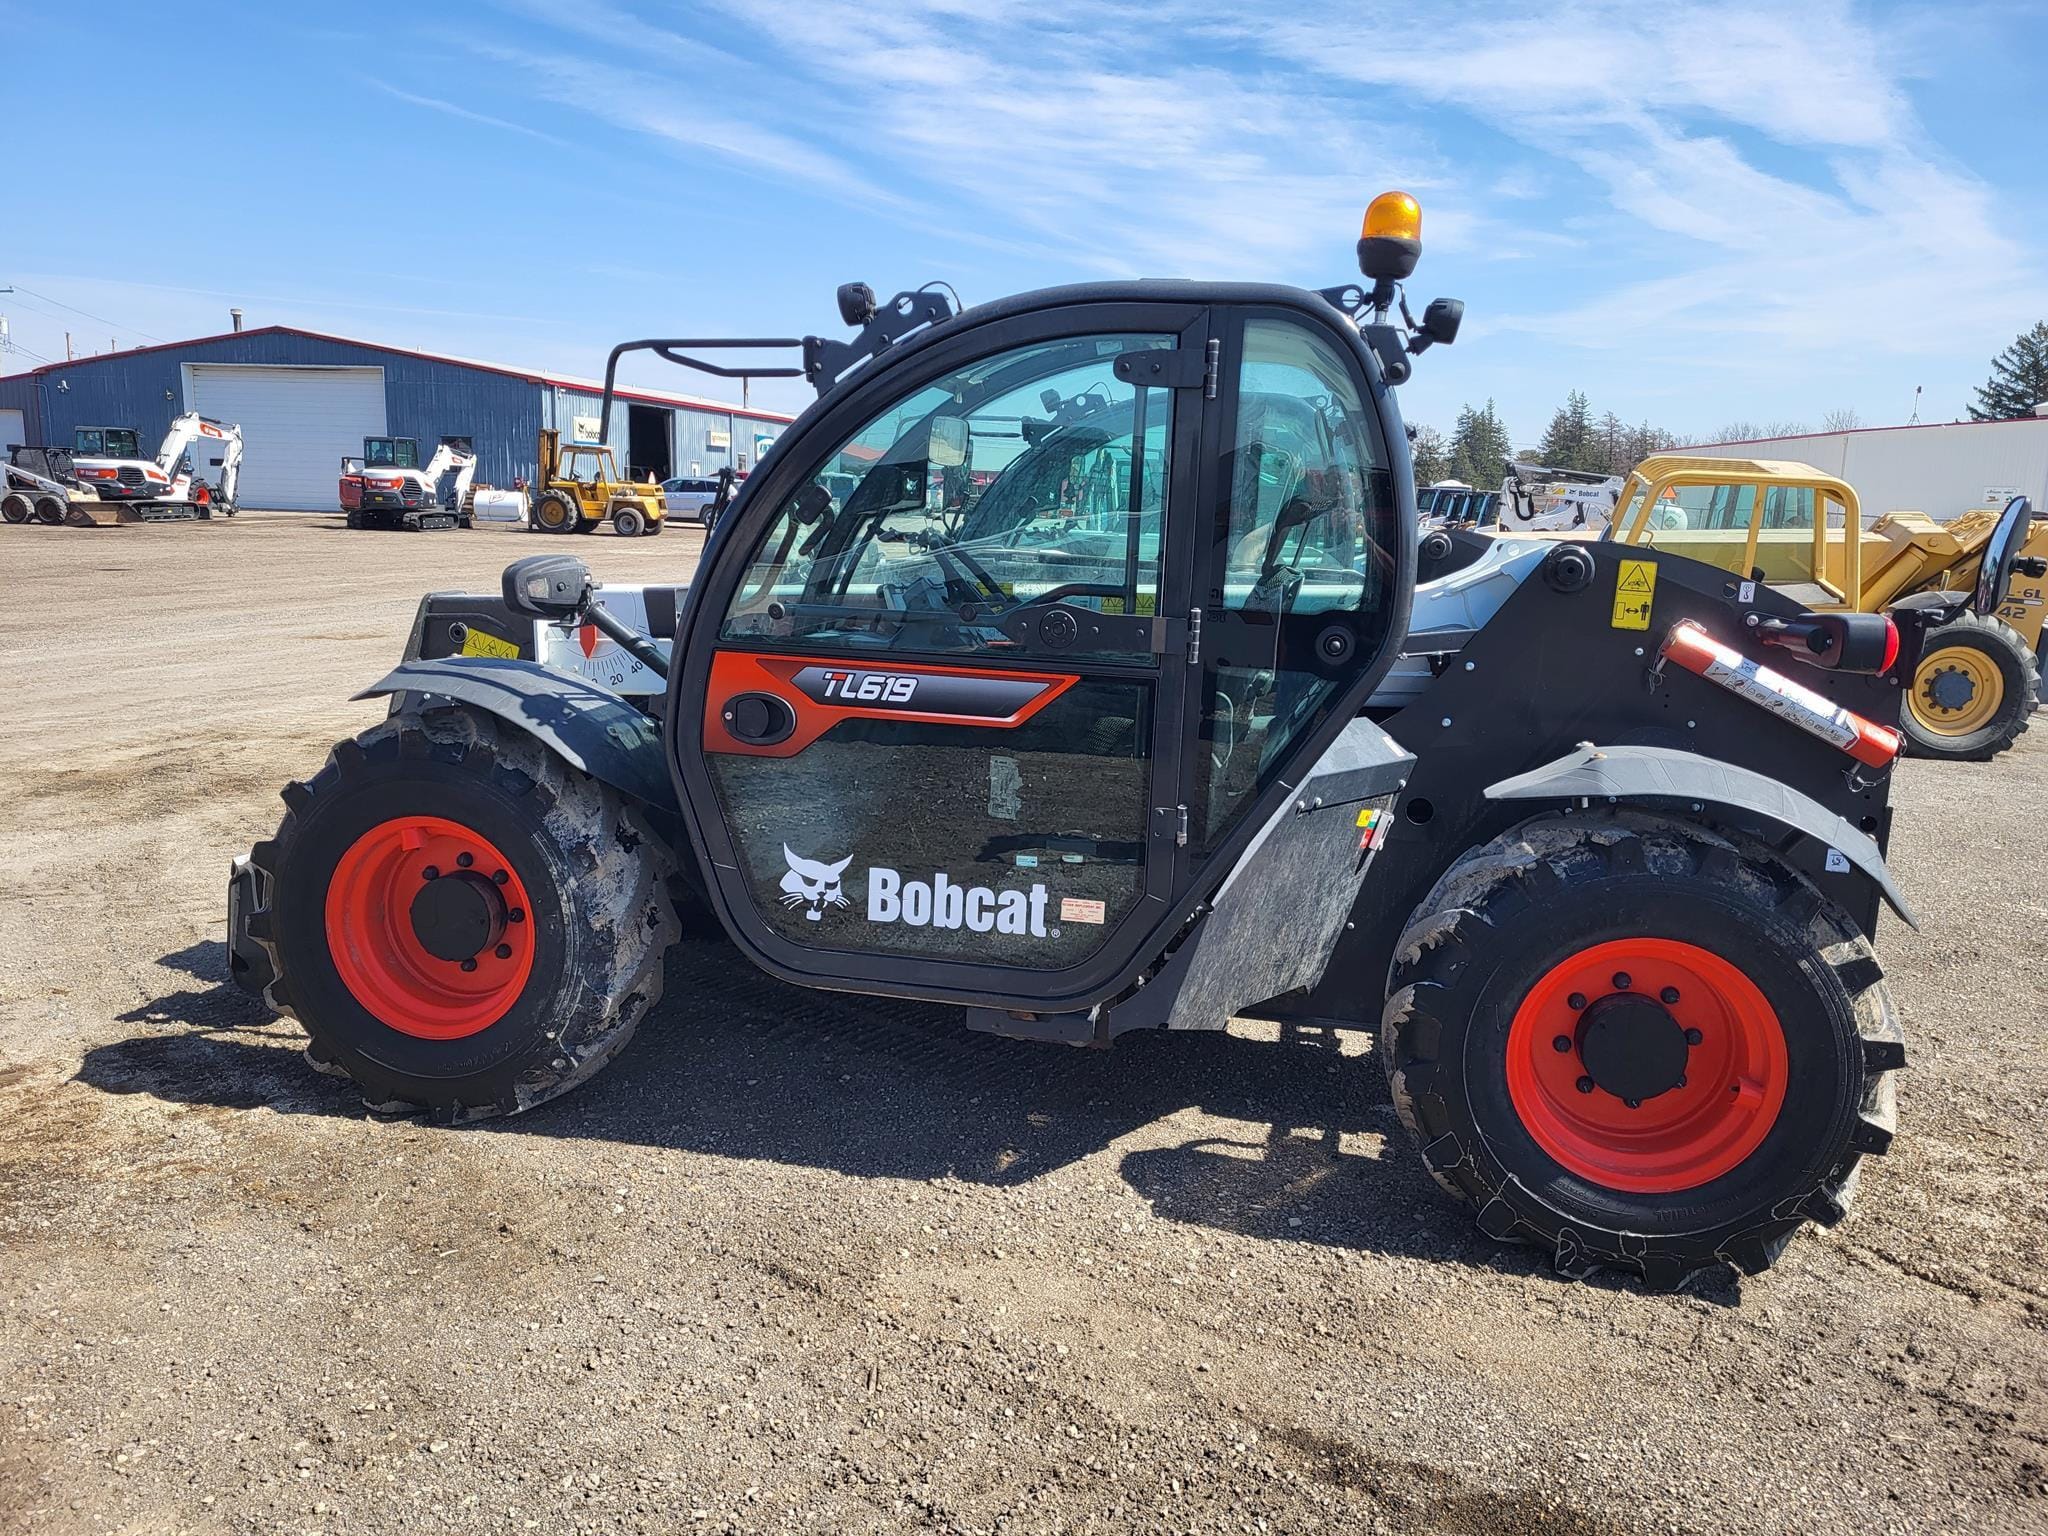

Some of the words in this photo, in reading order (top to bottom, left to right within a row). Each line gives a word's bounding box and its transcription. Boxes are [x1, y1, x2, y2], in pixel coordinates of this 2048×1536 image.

[1578, 490, 1600, 498] Bobcat
[1998, 607, 2026, 619] 42
[610, 673, 624, 686] 20
[631, 661, 643, 674] 40
[823, 672, 919, 703] TL619
[868, 867, 1048, 938] Bobcat
